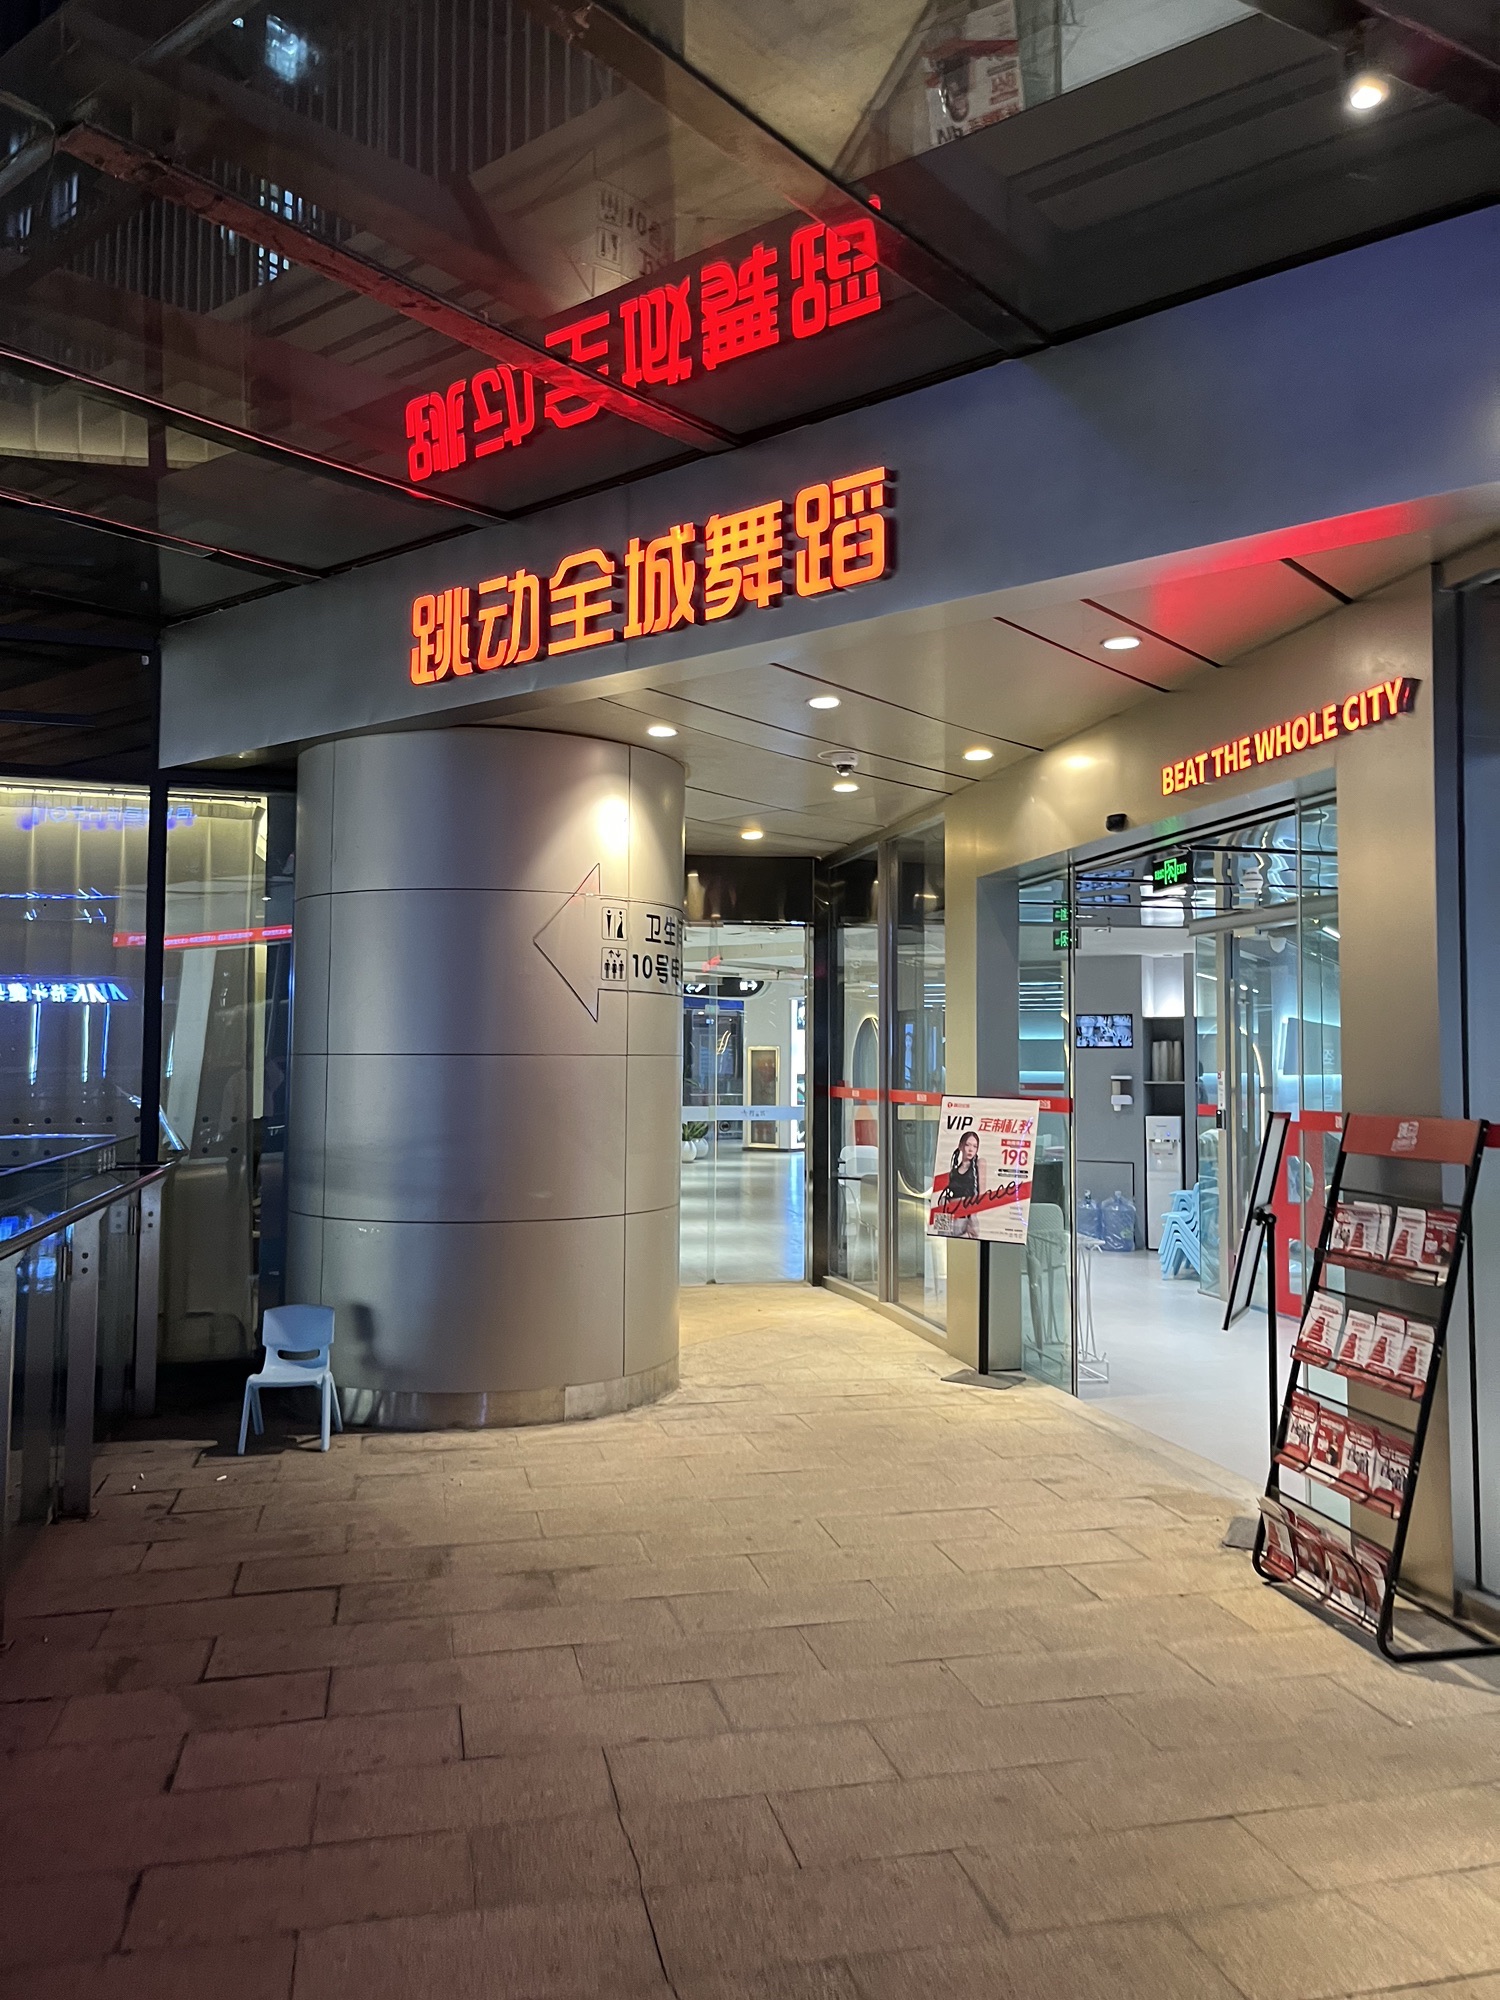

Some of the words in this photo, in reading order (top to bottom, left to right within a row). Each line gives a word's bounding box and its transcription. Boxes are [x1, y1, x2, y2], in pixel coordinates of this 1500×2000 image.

[410, 467, 886, 685] 跳动全城舞蹈
[1161, 752, 1208, 796] BEAT
[1211, 736, 1252, 778] THE
[1253, 703, 1339, 763] WHOLE
[1342, 676, 1404, 731] CITY
[947, 1115, 973, 1131] VIP
[978, 1117, 1034, 1135] 定制私教
[1001, 1149, 1029, 1166] 190
